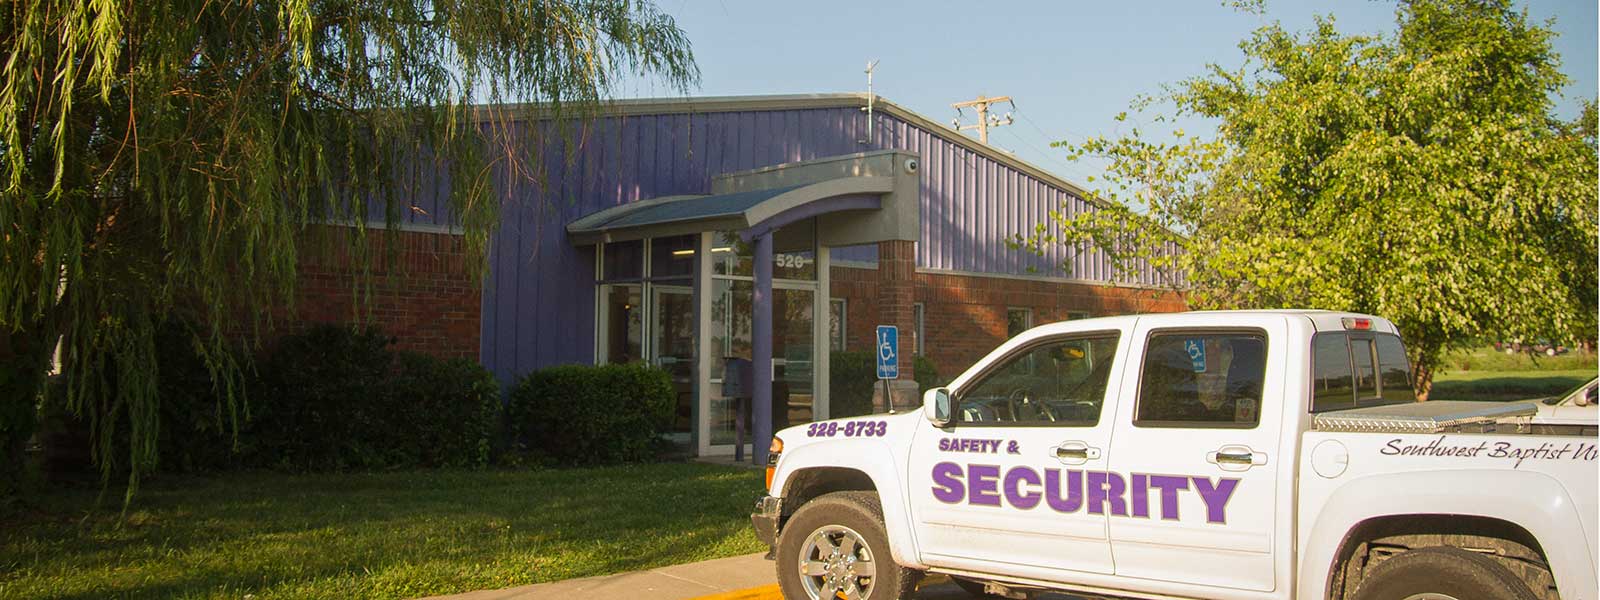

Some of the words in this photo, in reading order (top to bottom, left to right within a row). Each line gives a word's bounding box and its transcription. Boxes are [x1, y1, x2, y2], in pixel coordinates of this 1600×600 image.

[807, 420, 887, 437] 328-8733
[938, 438, 1002, 453] SAFETY
[1007, 440, 1021, 454] &
[1380, 435, 1486, 457] Southwest
[1487, 441, 1571, 469] Baptist
[931, 461, 1242, 524] SECURITY
